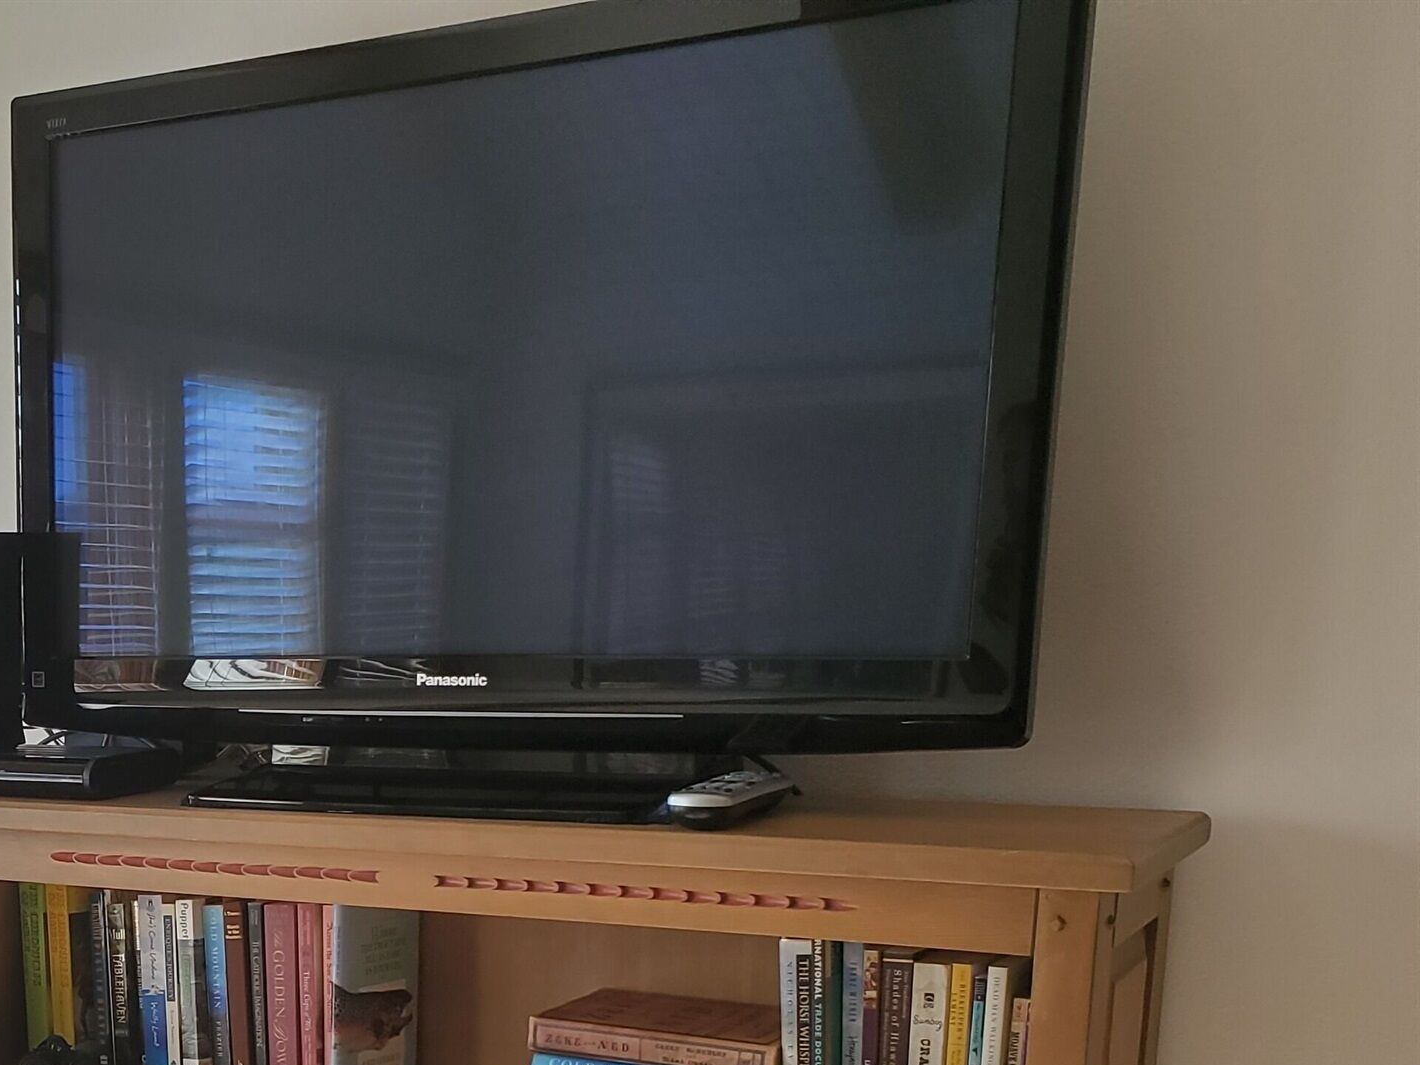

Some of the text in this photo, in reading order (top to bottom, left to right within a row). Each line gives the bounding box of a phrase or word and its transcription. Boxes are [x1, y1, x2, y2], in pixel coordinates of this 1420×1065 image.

[416, 673, 488, 686] Panasonic
[180, 903, 189, 939] Puppet
[209, 909, 218, 943] COLD
[252, 941, 260, 954] THE
[112, 953, 128, 1024] FABLEHAVEN
[166, 962, 175, 999] JOURNEY
[210, 946, 222, 1009] MOUNTAIN
[273, 949, 286, 1018] GOLDEN
[798, 958, 810, 983] THE
[993, 976, 1001, 1000] DEAD
[302, 971, 311, 1011] Three Cups
[786, 961, 794, 1035] NICHOLAS
[798, 984, 810, 1024] HORSE
[892, 969, 902, 1009] Shades
[254, 996, 264, 1048] IMAGINATION
[815, 1003, 823, 1037] TRADE
[891, 1015, 900, 1028] of
[949, 993, 958, 1025] LAMENT
[957, 983, 966, 1041] BEEKEEPER'S
[991, 1004, 999, 1023] MAN
[544, 1033, 630, 1054] ZEKE NED
[988, 1027, 997, 1065] WALKING
[1010, 1032, 1020, 1062] MOJAVE
